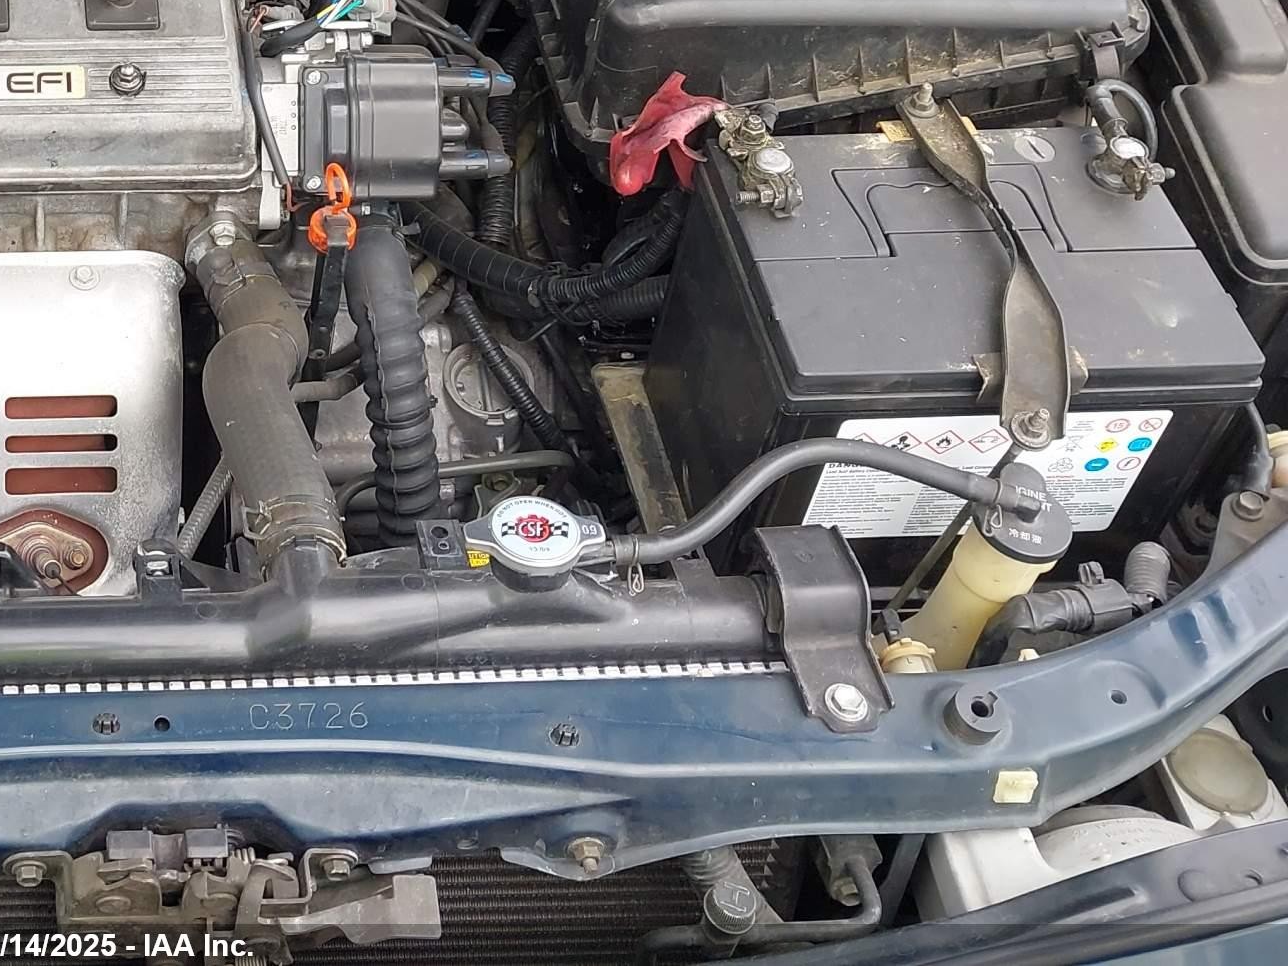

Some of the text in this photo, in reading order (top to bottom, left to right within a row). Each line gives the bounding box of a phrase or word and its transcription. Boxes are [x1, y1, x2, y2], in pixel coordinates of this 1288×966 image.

[6, 72, 72, 94] EFI
[534, 500, 554, 510] WHEN
[518, 522, 544, 536] CSF
[249, 702, 369, 730] C3726
